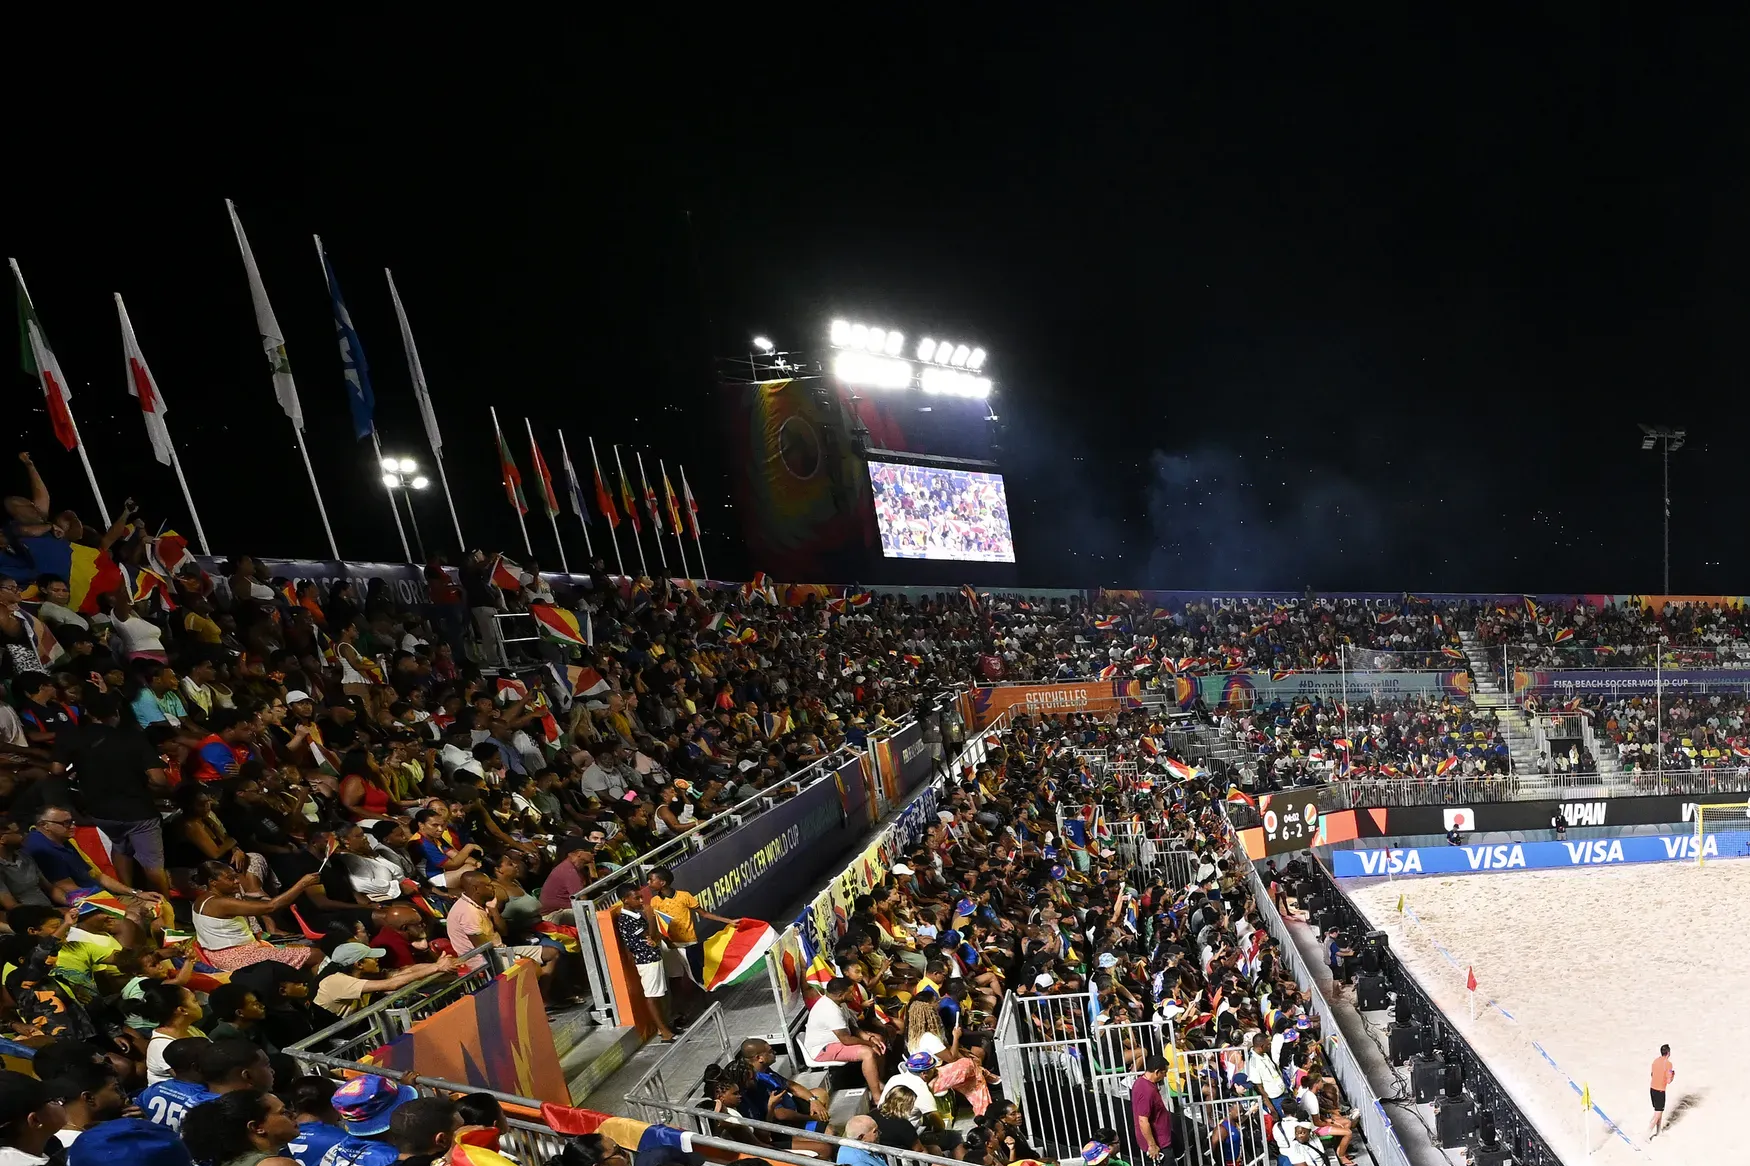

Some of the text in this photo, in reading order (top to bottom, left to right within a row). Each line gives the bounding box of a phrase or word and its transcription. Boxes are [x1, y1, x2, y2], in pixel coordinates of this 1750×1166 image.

[1553, 680, 1573, 688] FIFA
[1575, 680, 1604, 688] BEACH
[1605, 679, 1638, 688] SOCCER
[1672, 679, 1689, 687] CUP
[1025, 689, 1088, 711] SEYCHELLES
[1551, 802, 1607, 827] JAPAN
[1460, 844, 1526, 870] VISA
[1562, 840, 1625, 864] VISA
[1658, 834, 1719, 859] VISA
[713, 865, 742, 907] BEACH
[741, 849, 767, 888] SOCCER
[765, 833, 788, 868] WORLD
[786, 823, 800, 850] CUP
[1353, 850, 1423, 874] VISA
